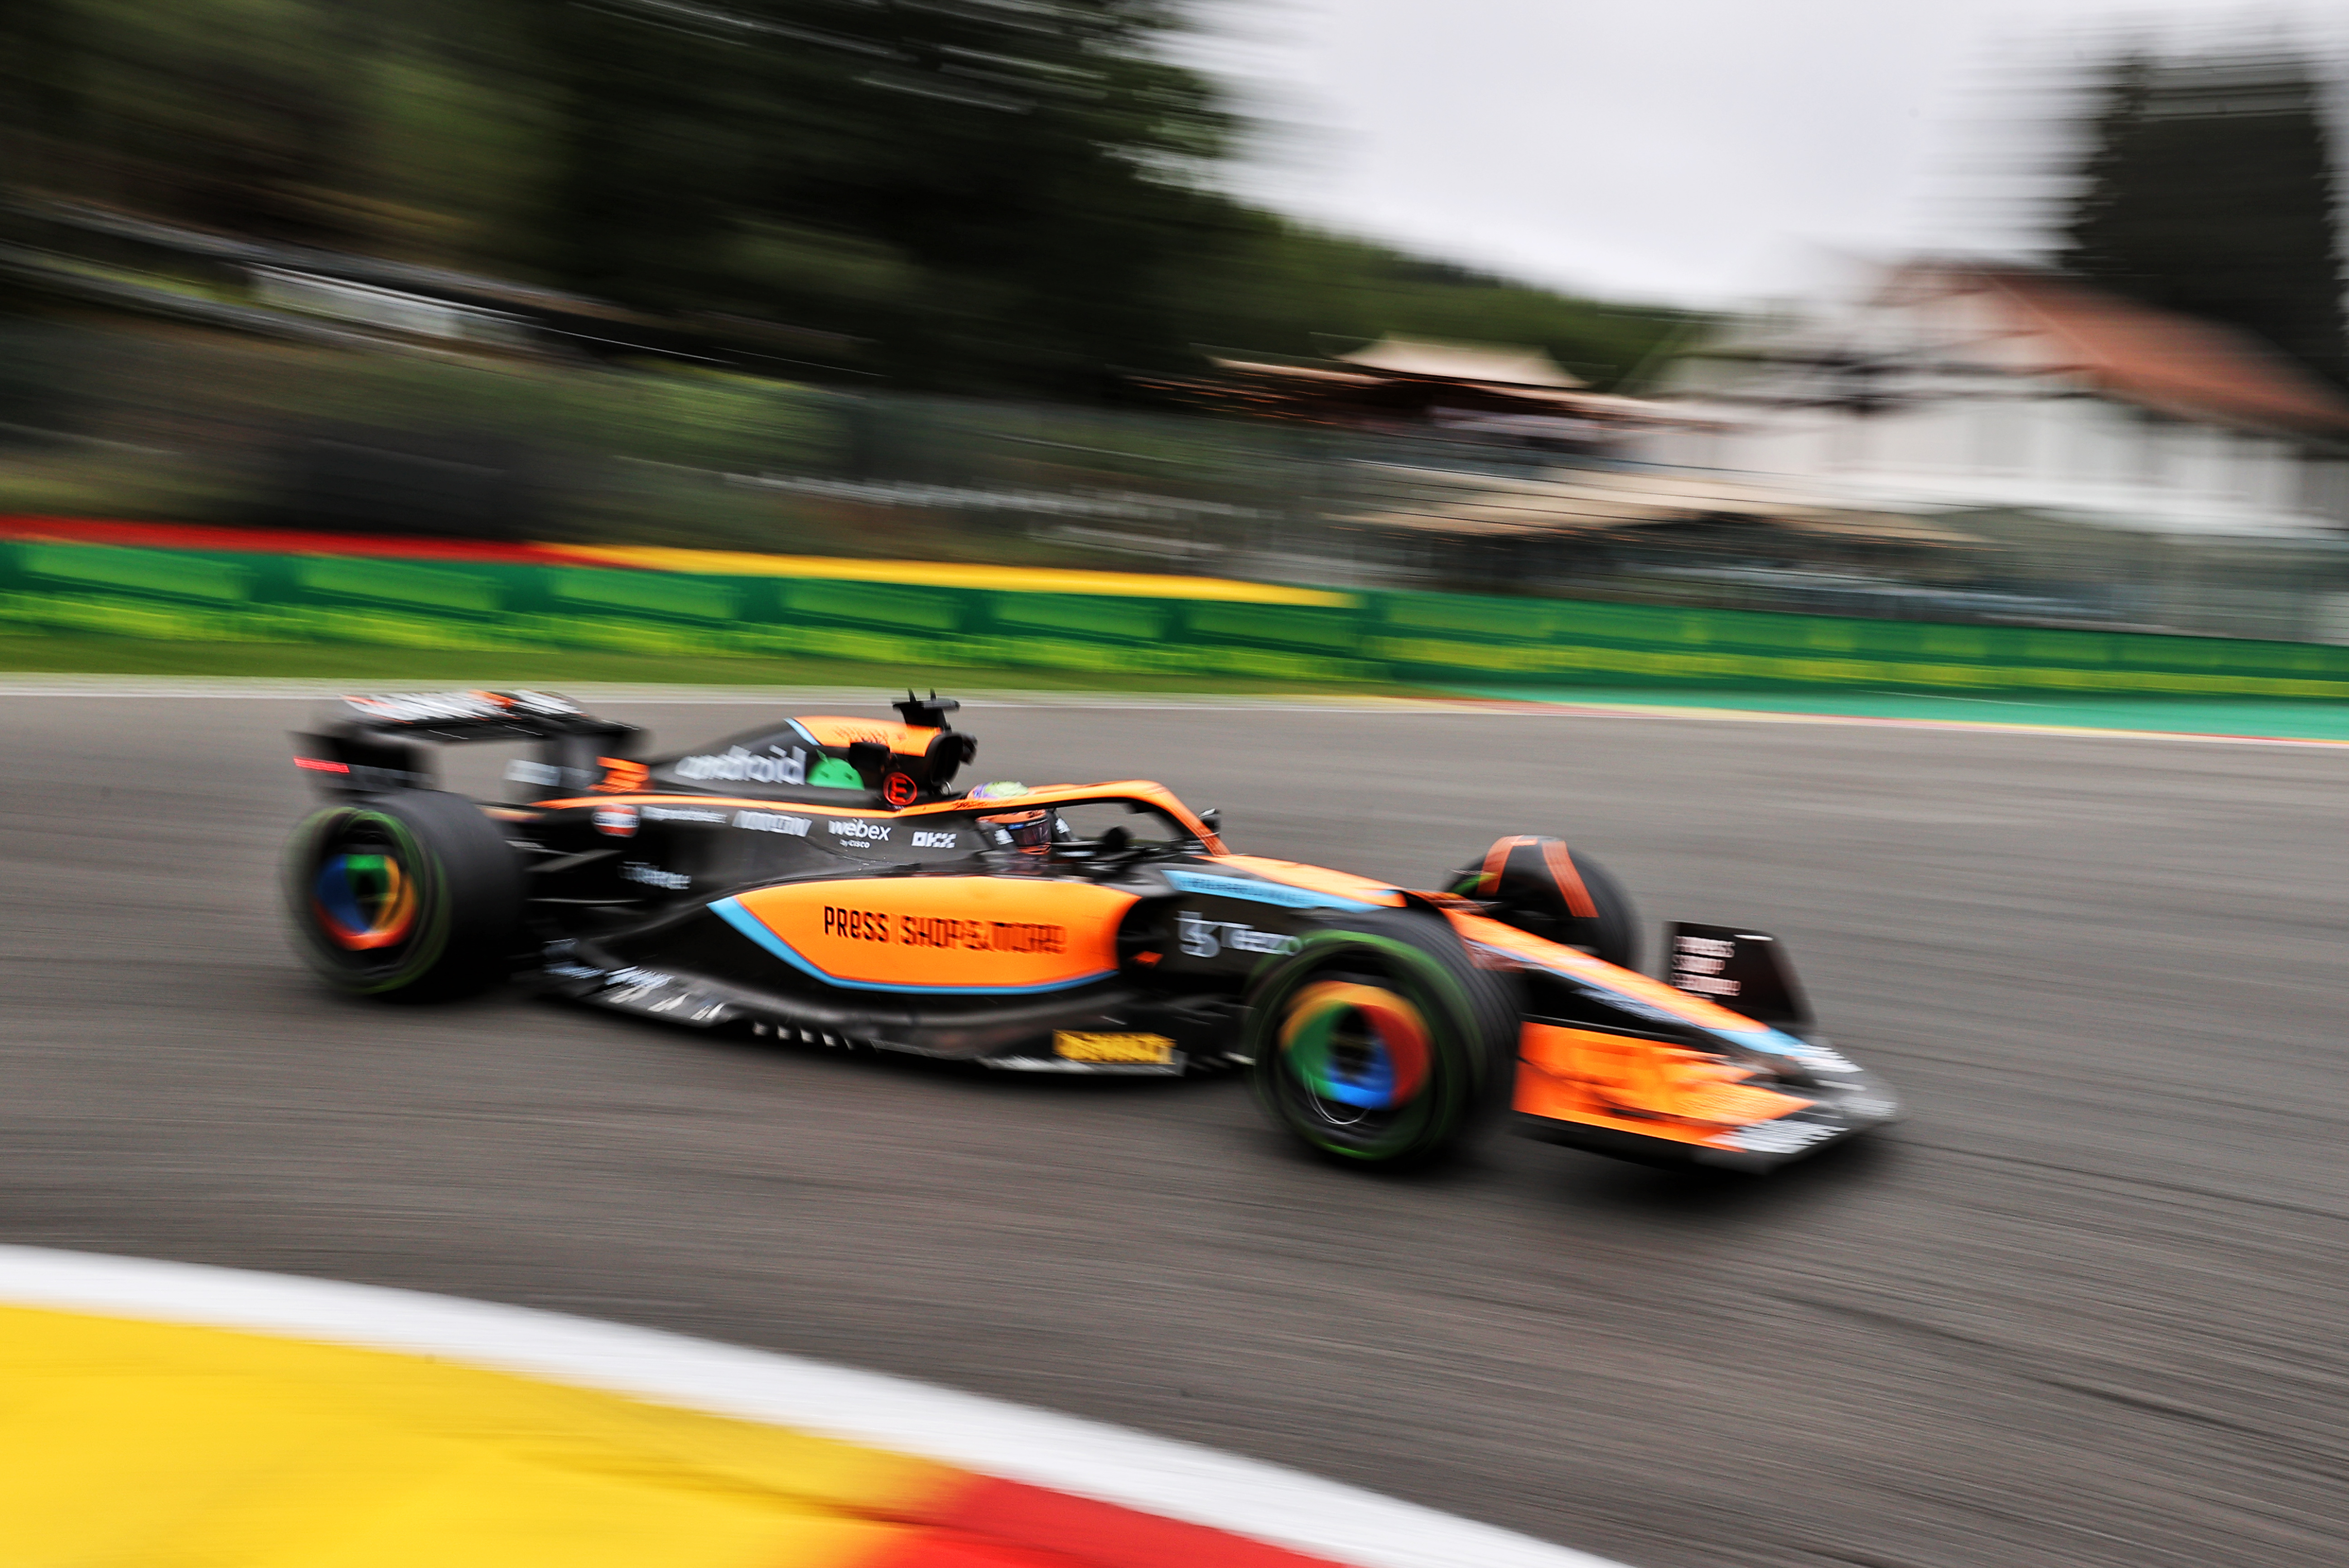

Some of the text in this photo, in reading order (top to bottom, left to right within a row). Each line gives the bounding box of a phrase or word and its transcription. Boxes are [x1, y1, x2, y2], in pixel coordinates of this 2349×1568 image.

[889, 777, 907, 802] E
[828, 818, 891, 841] webex
[912, 831, 957, 849] OKX
